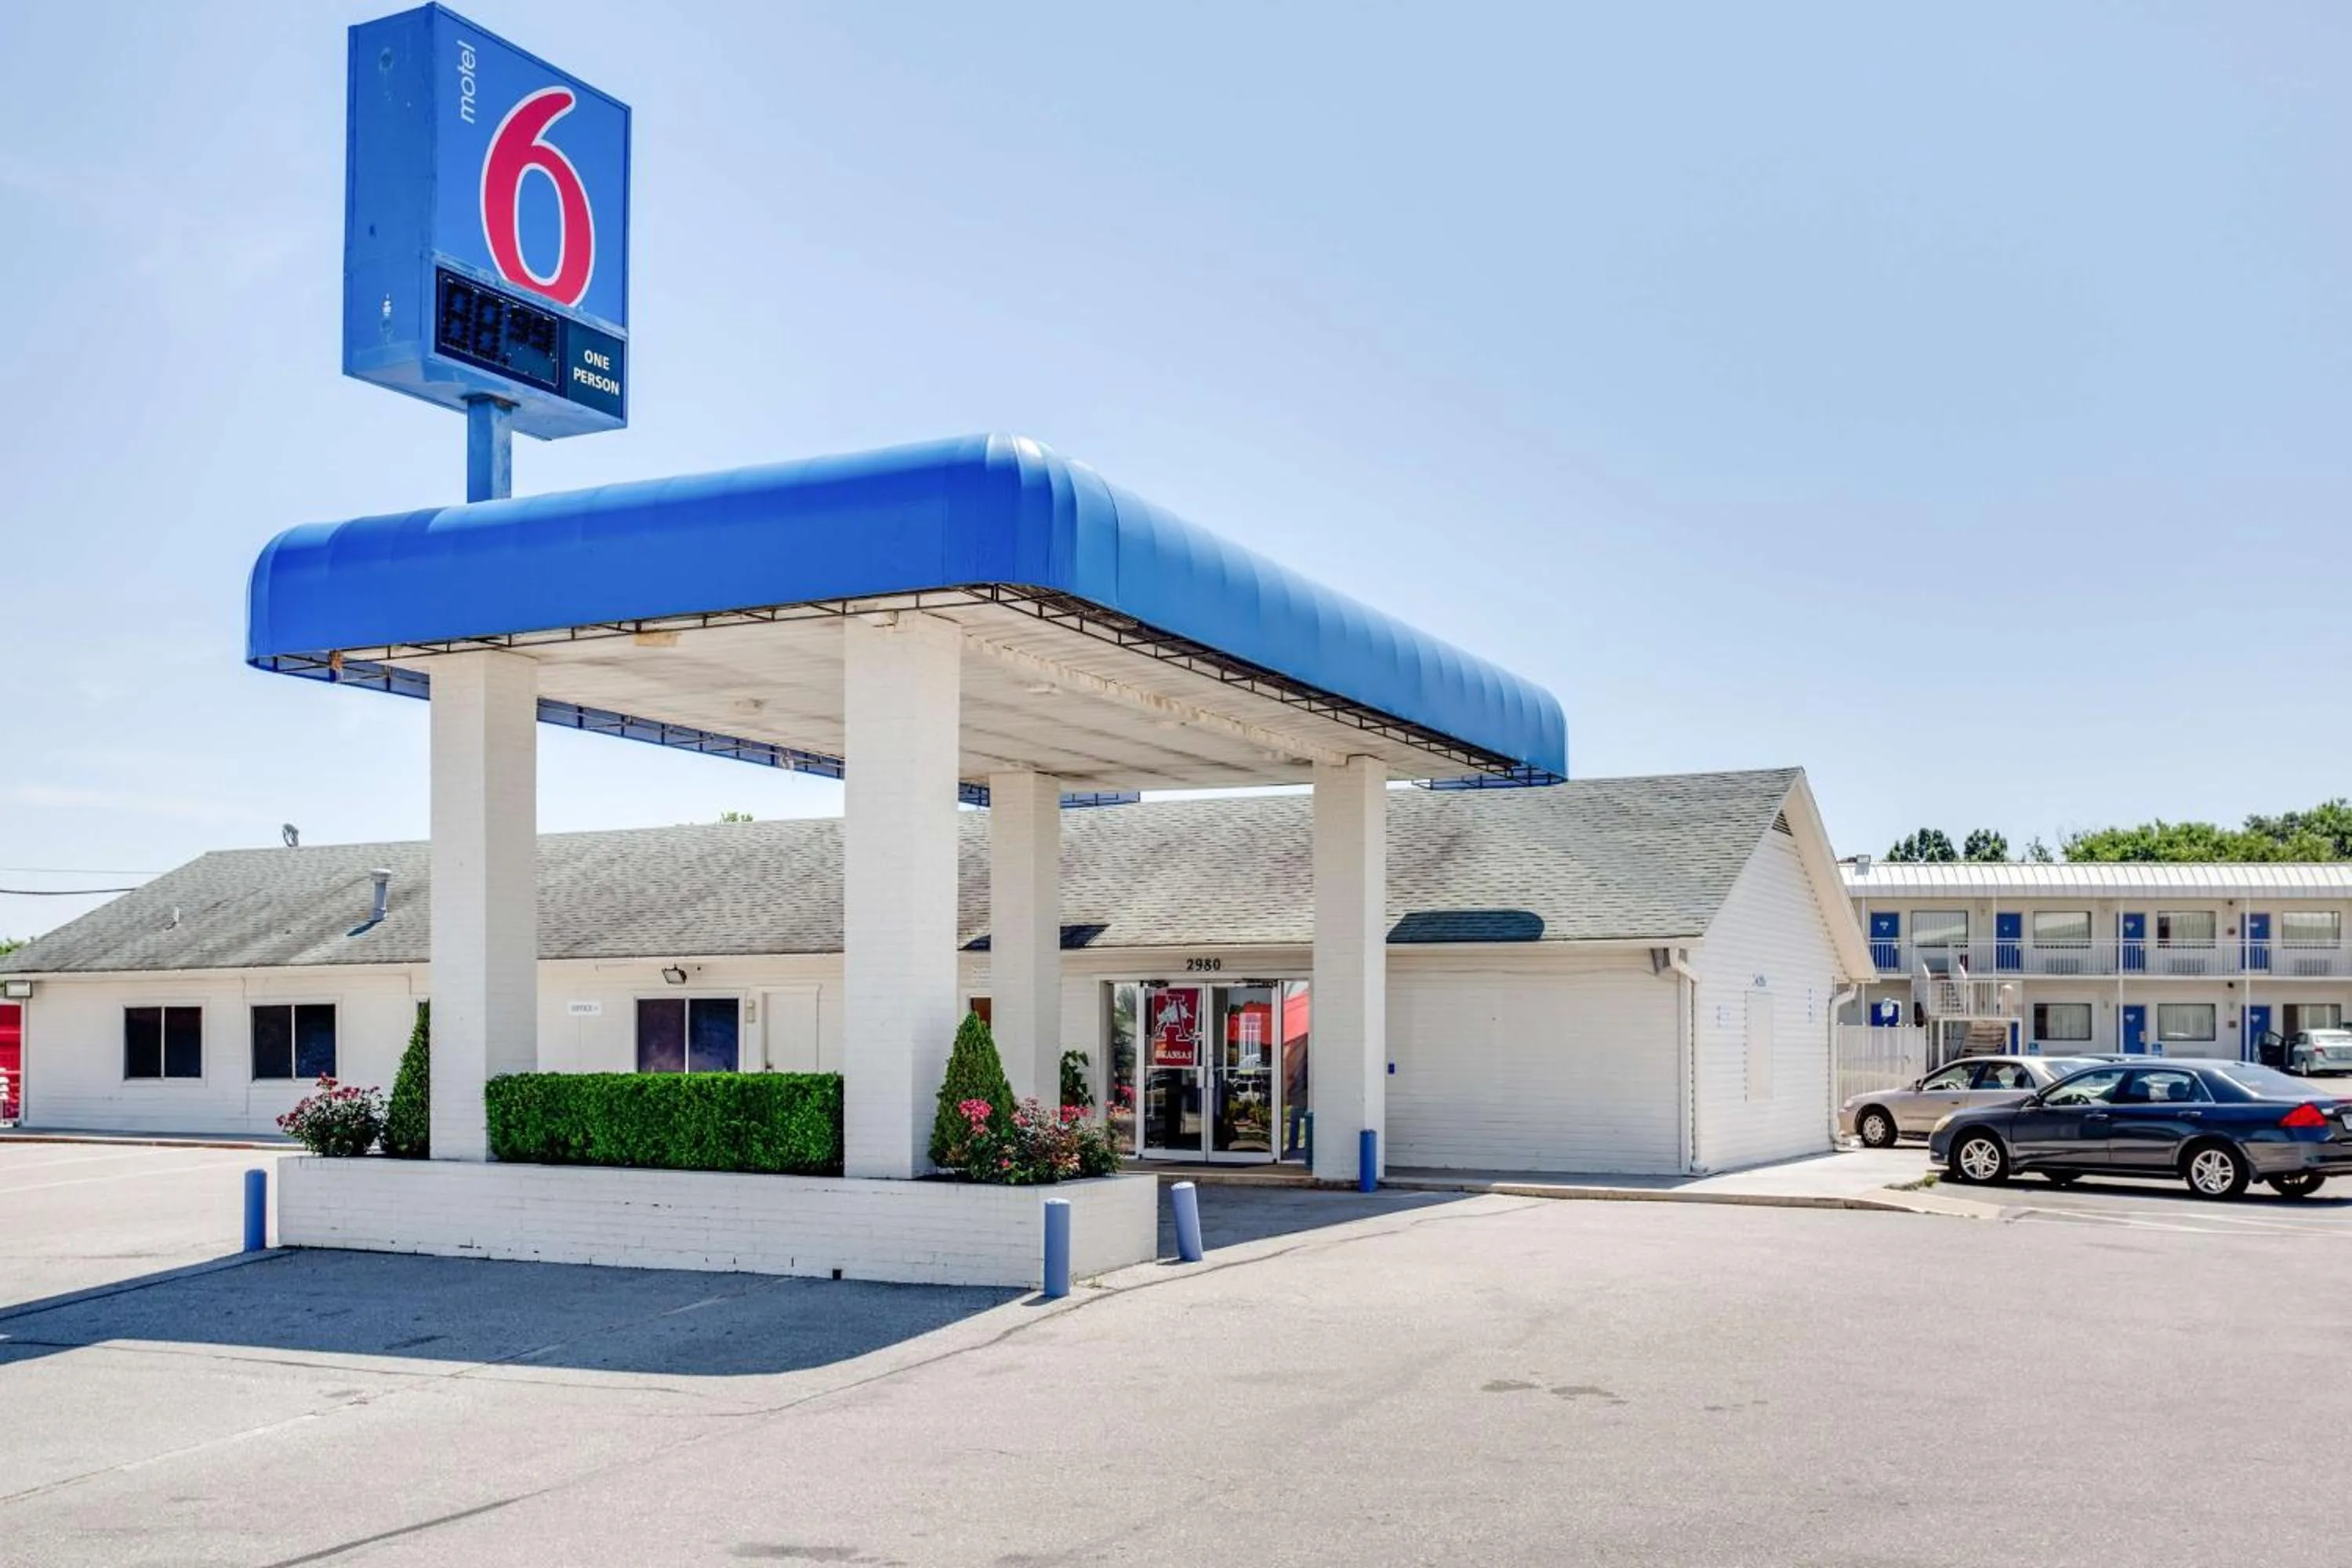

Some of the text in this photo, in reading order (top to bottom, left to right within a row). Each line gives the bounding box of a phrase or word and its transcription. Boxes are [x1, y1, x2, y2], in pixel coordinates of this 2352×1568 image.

[457, 39, 476, 124] motel
[479, 85, 595, 307] 6
[584, 350, 610, 371] ONE
[573, 366, 620, 396] PERSON
[1186, 958, 1221, 971] 2980
